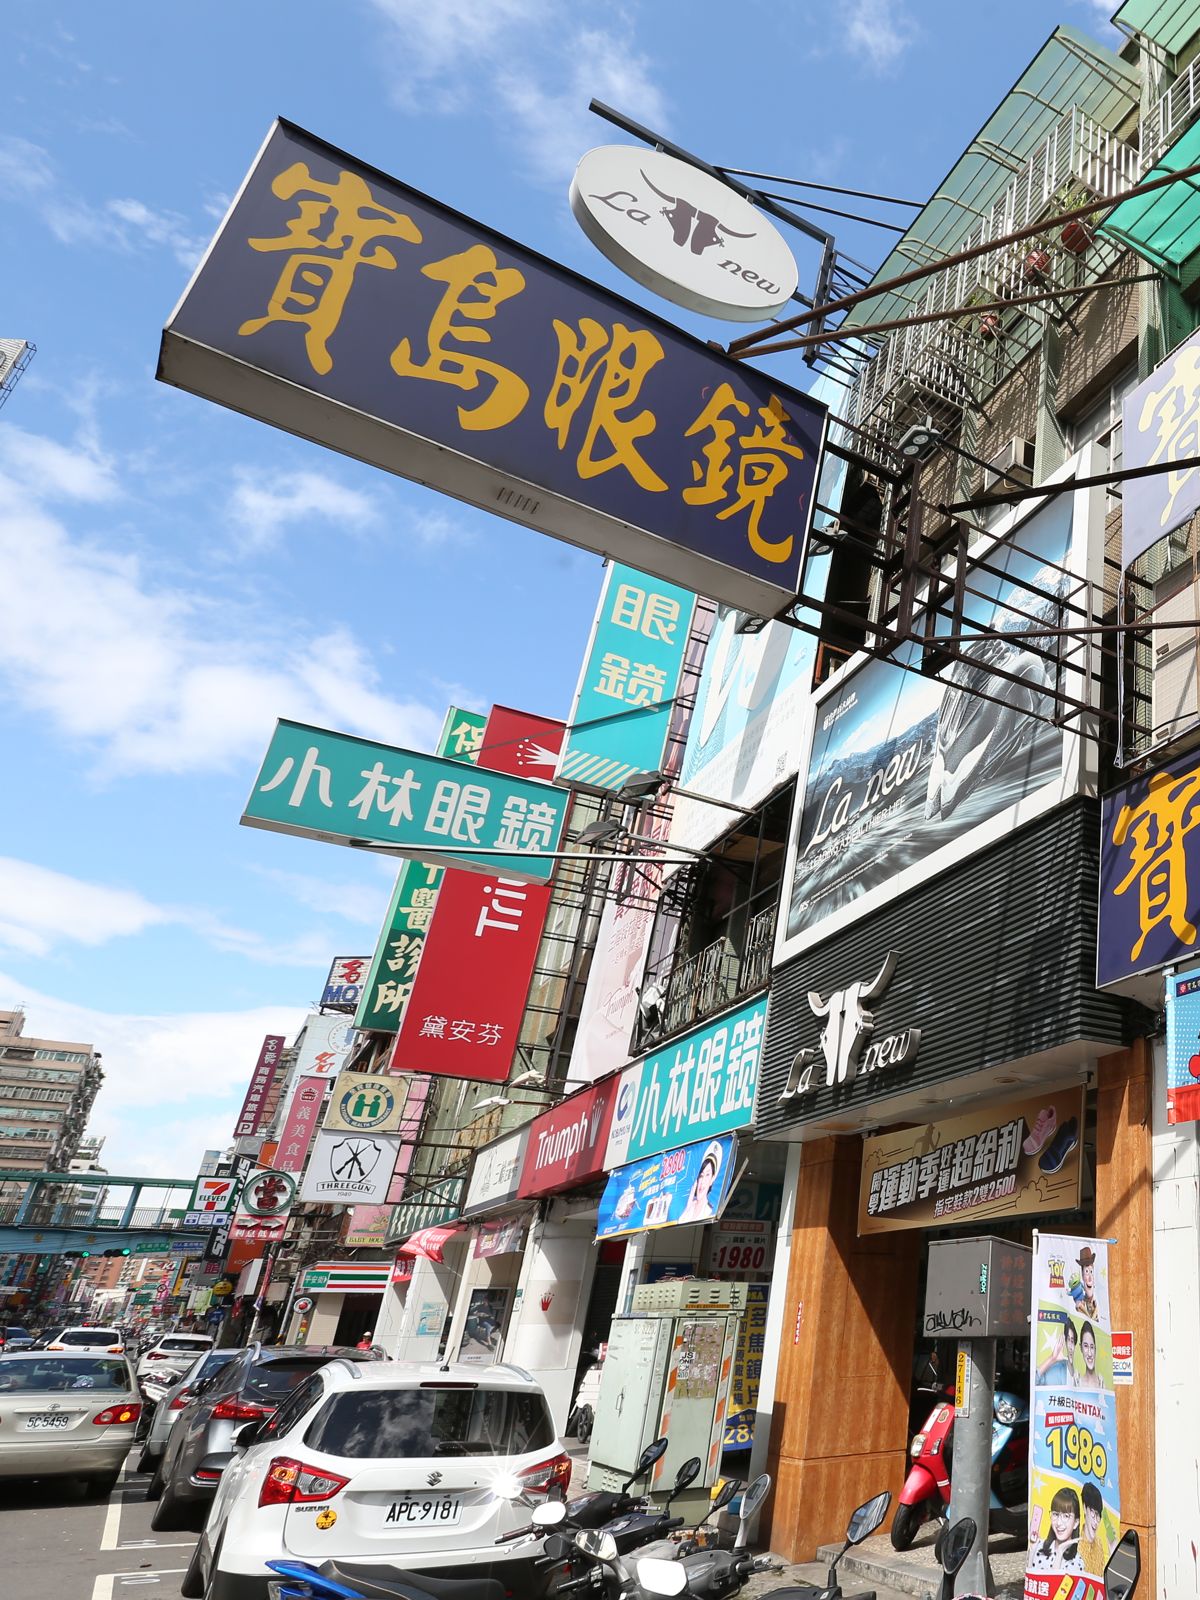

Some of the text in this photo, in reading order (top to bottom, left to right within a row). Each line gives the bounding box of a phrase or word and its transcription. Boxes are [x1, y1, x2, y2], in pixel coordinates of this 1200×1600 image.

[588, 191, 780, 295] La new
[237, 162, 806, 563] 寶島眼鏡
[593, 583, 682, 712] 眼鏡
[261, 746, 559, 853] 小林眼鏡
[804, 738, 922, 858] La new
[475, 876, 530, 938] Tri
[325, 985, 363, 1003] MO
[419, 1014, 504, 1046] 黛安芬
[632, 1009, 764, 1147] 小林眼鏡
[777, 1028, 917, 1103] La new
[535, 1111, 589, 1170] Triumph
[320, 1182, 372, 1192] THREEGUN
[718, 1246, 765, 1269] 1980
[1046, 1424, 1108, 1479] 1980
[294, 1505, 330, 1513] SUZUKI
